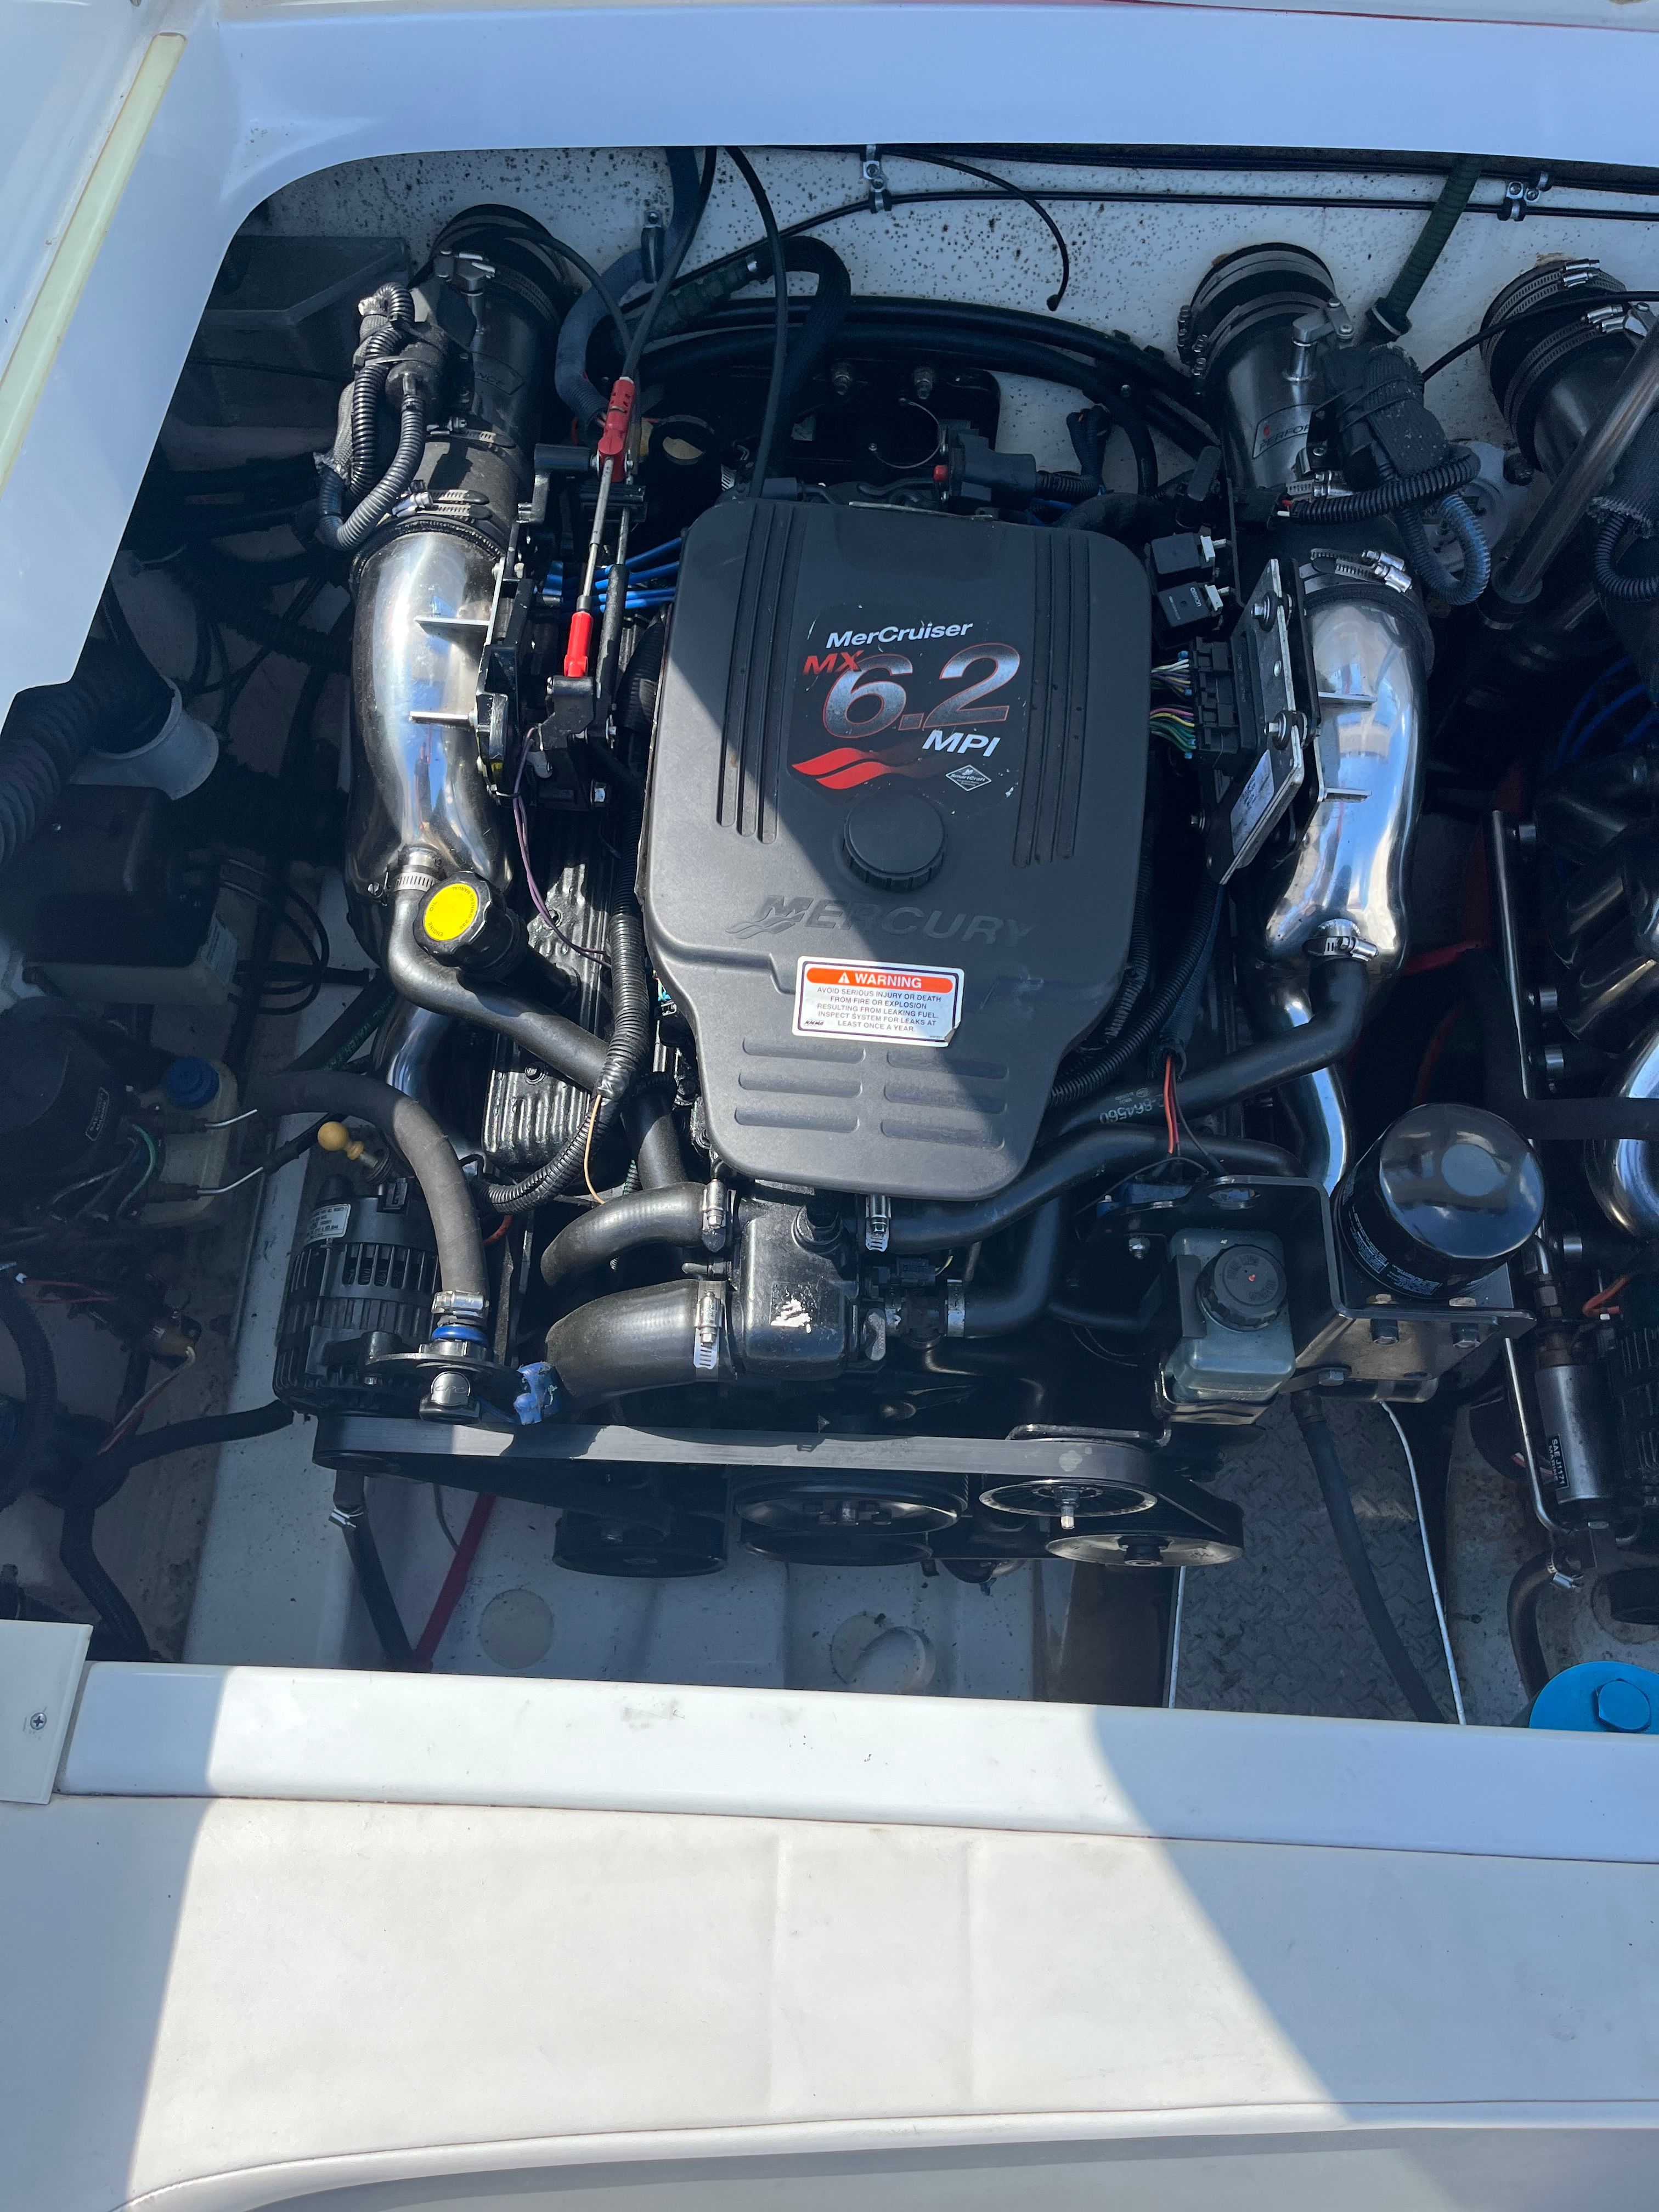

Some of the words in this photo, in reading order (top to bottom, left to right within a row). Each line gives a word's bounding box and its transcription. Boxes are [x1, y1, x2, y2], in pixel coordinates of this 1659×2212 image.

[826, 623, 973, 648] MerCruiser
[803, 650, 864, 675] MX
[823, 642, 1020, 738] 6.2
[922, 730, 1001, 757] MPI
[452, 887, 471, 895] MANUAL
[428, 922, 443, 936] ENGINE
[746, 895, 1033, 947] MERCURY
[855, 973, 922, 989] WARNING
[817, 1003, 858, 1012] RESULTING
[885, 1001, 927, 1009] EXPLOSION
[1551, 1438, 1560, 1457] SAE
[1555, 1459, 1565, 1484] J1171
